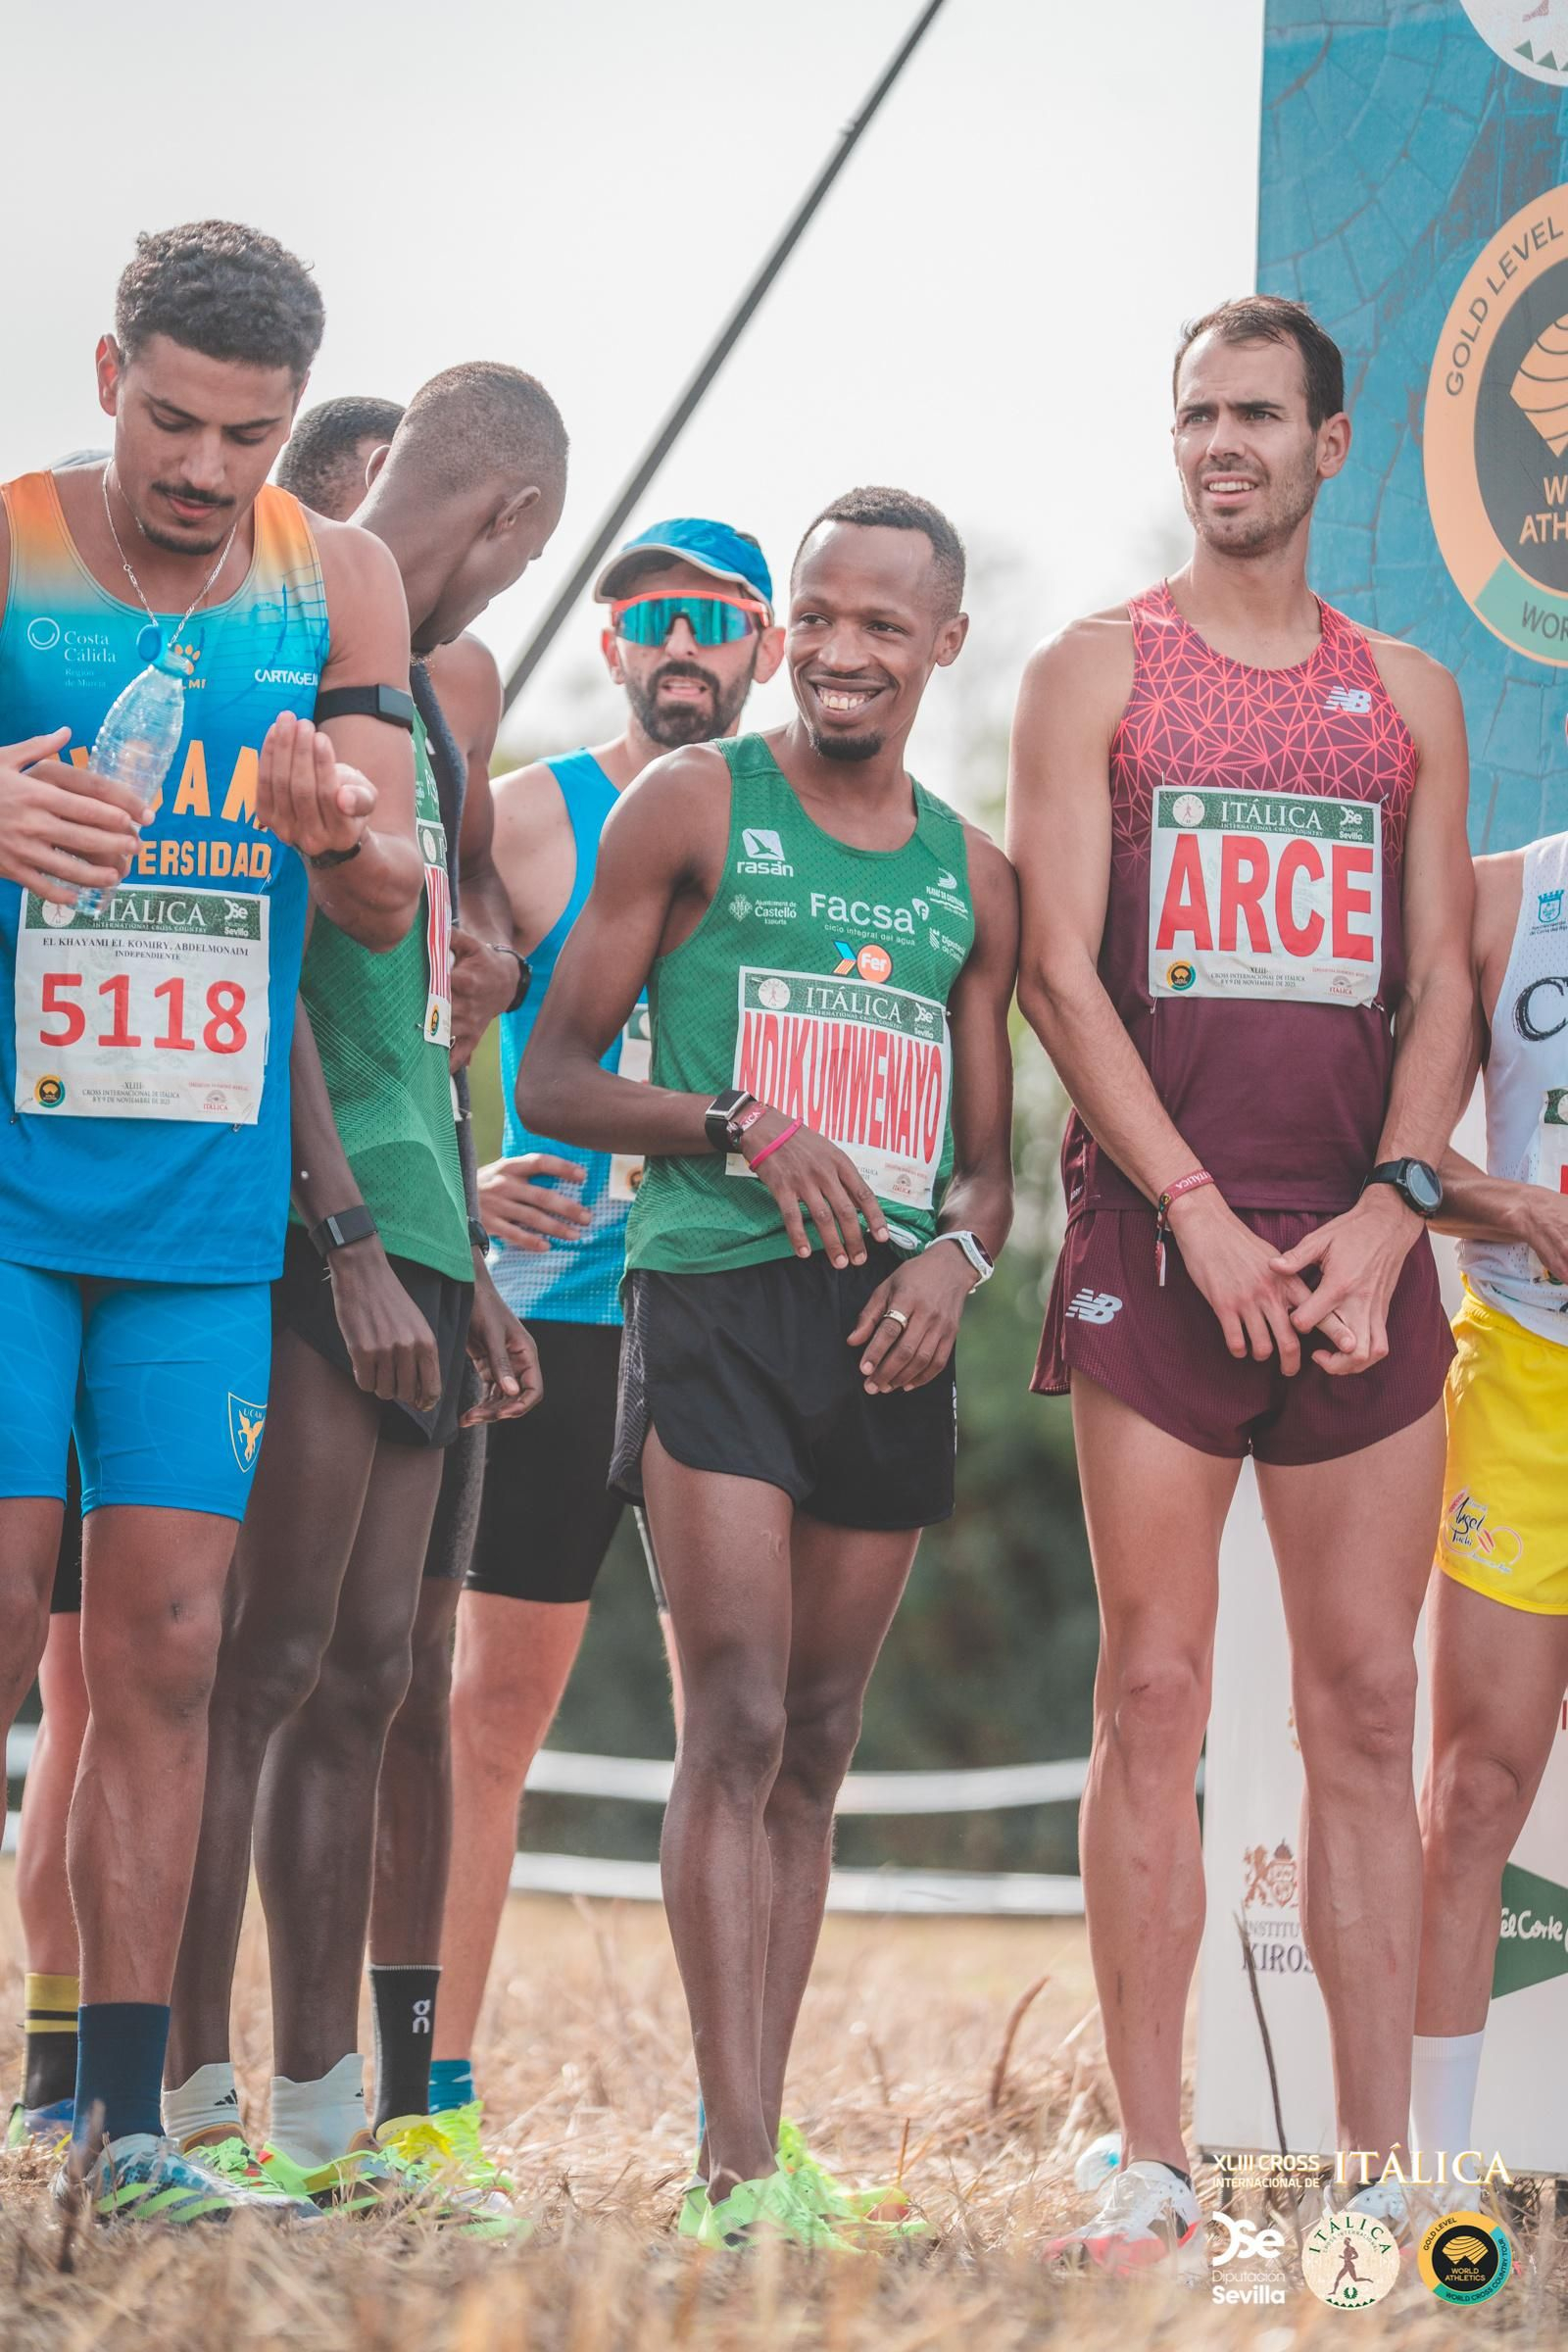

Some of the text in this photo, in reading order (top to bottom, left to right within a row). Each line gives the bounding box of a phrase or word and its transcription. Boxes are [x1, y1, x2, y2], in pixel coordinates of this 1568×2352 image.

[1446, 216, 1564, 396] GOLD LEVEL
[64, 630, 109, 645] Costa
[64, 647, 116, 662] Cálida
[1221, 799, 1323, 830] ITÁLICA
[1340, 831, 1363, 841] Sevilla
[126, 840, 272, 878] ERSIDAD
[737, 860, 794, 878] rasán
[1155, 834, 1374, 962] ARCE
[755, 906, 797, 918] Castelló
[810, 893, 915, 935] Facsa
[43, 938, 56, 947] EL
[59, 938, 110, 949] KHAYAMI
[112, 939, 124, 948] EL
[174, 942, 250, 956] ABDELMONAIM
[846, 927, 878, 940] integral
[896, 936, 916, 947] agua
[115, 951, 181, 960] INDEPENDIENTE
[861, 953, 887, 972] Fer
[40, 973, 248, 1054] 5118
[806, 986, 903, 1024] ITÁLICA
[739, 1011, 942, 1164] NDIKUMWENAYO
[1518, 1910, 1563, 1941] Corte
